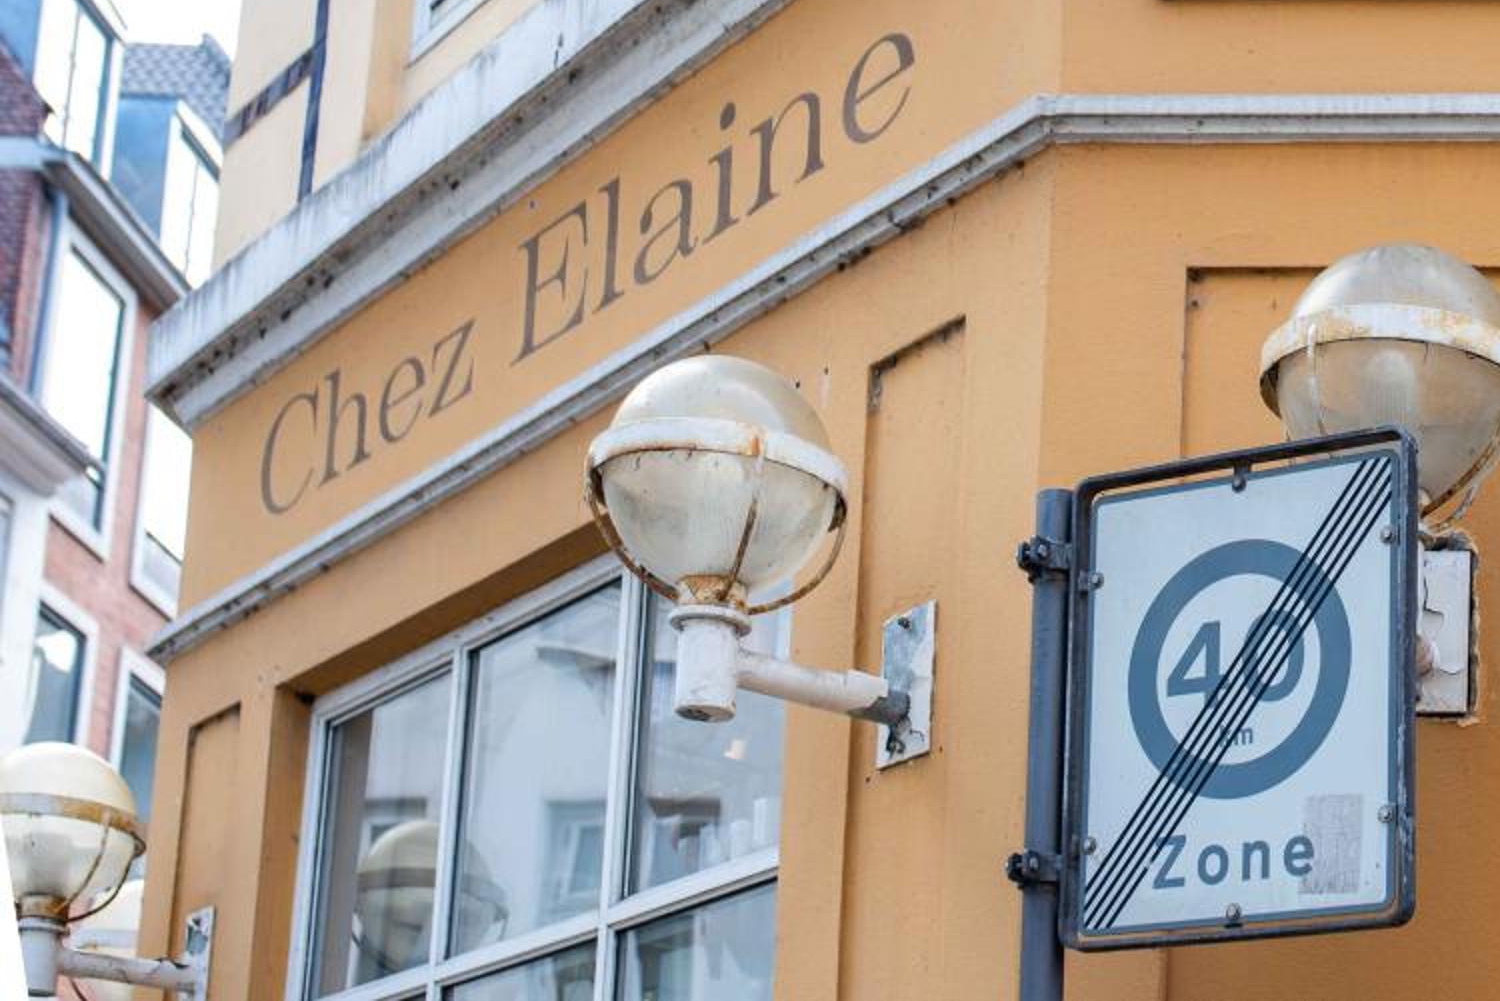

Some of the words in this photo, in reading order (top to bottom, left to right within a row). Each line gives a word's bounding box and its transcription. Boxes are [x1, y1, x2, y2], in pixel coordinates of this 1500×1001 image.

[260, 318, 478, 515] Chez
[509, 32, 917, 370] Elaine
[1167, 612, 1304, 711] 40
[1152, 834, 1315, 890] Zone
